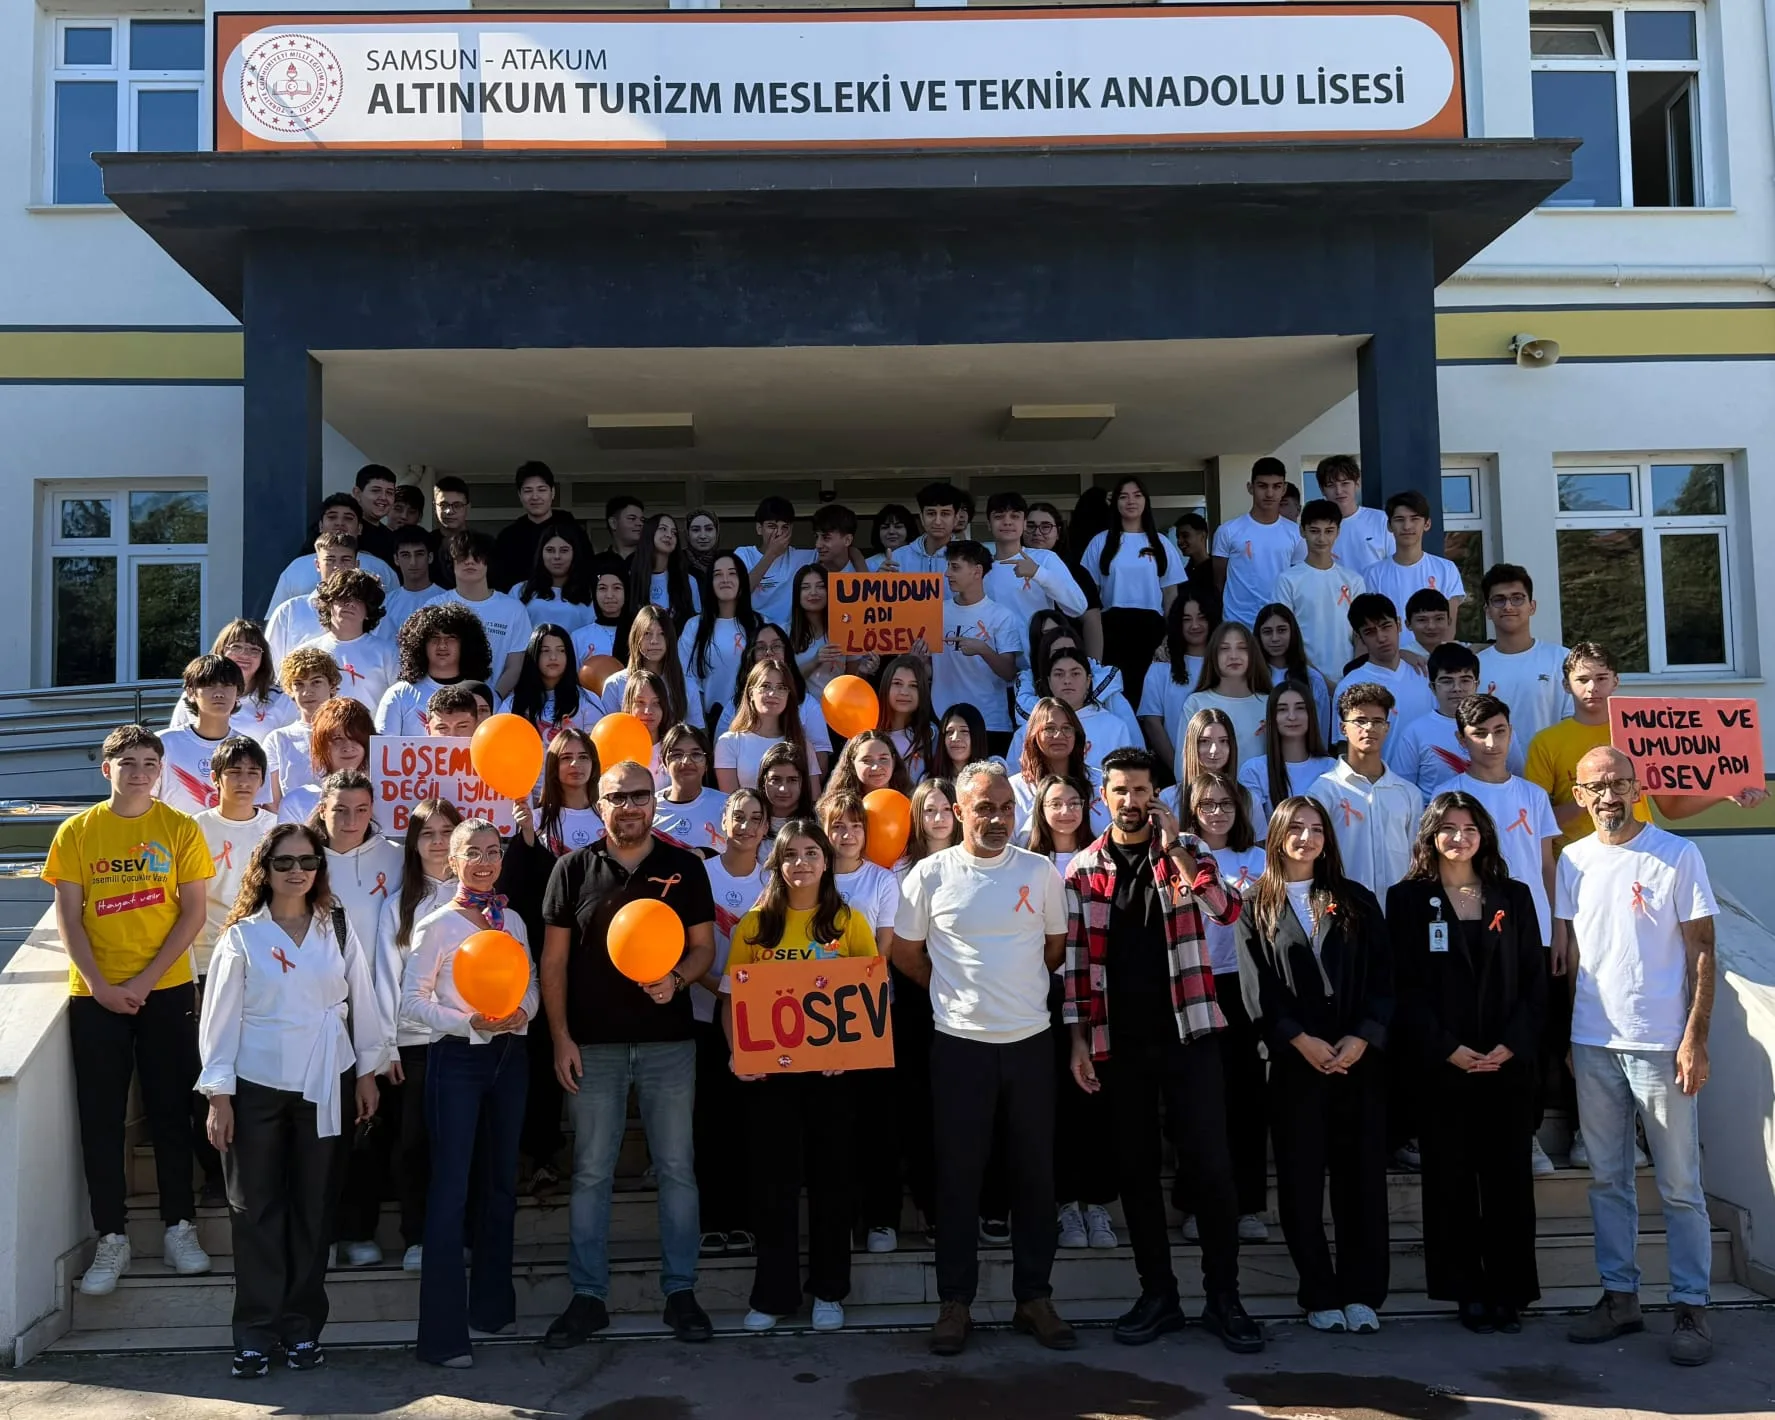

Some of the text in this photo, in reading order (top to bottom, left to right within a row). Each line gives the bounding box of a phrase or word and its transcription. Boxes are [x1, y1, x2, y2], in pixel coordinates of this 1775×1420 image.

[366, 49, 478, 72] SAMSUN
[501, 48, 607, 71] ATAKUM
[367, 66, 1404, 115] ALTINKUM TURİZM MESLEKİ VE TEKNİK ANADOLU LİSESİ
[836, 578, 940, 603] UMUDUN
[864, 607, 892, 624] ADI
[846, 626, 926, 653] LÖSEV
[1621, 706, 1754, 729] MUCİZE VE
[382, 742, 479, 776] LÖSEM
[1628, 735, 1749, 775] UMUDUN ADI
[1641, 762, 1716, 790] ÖSEV
[736, 982, 888, 1052] LÖSEV
